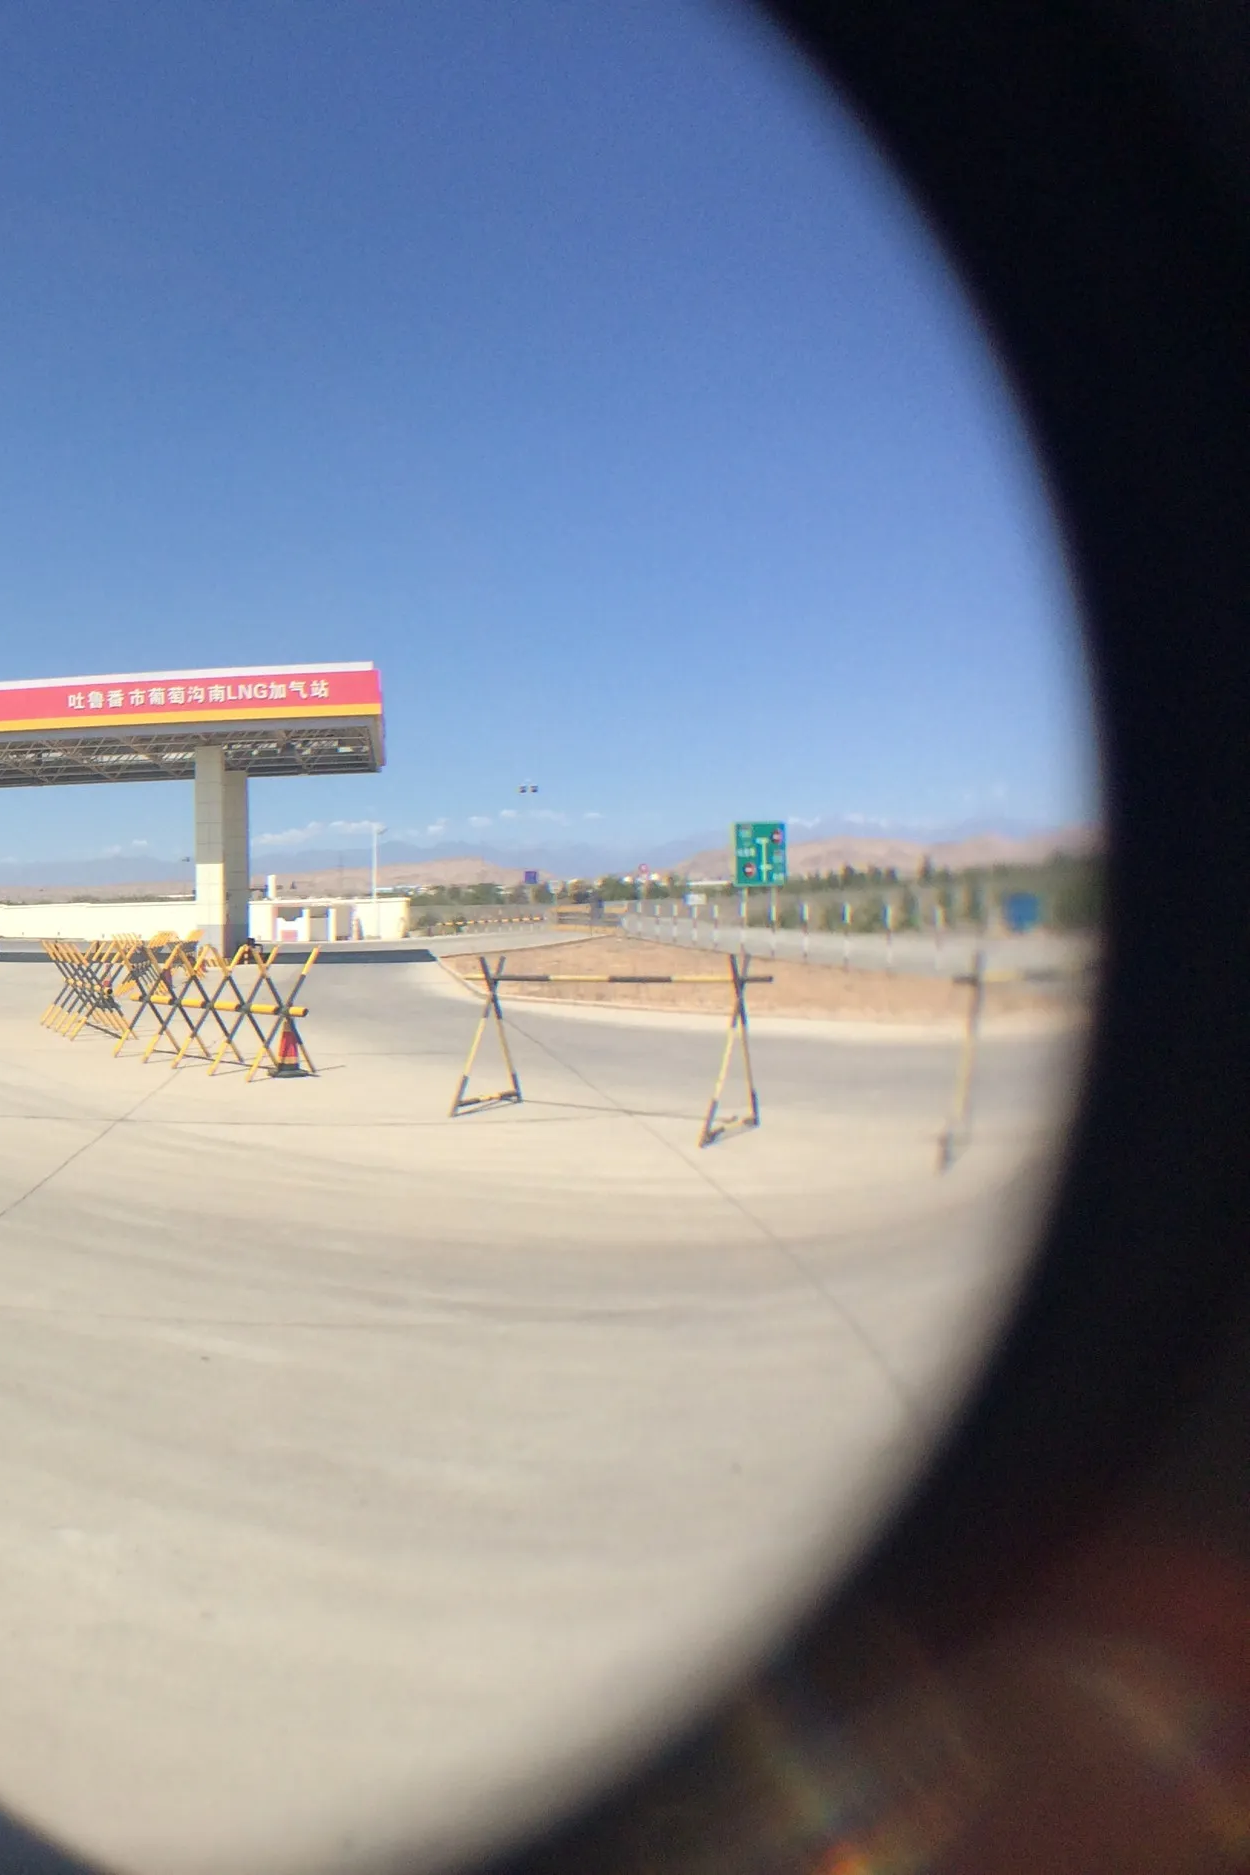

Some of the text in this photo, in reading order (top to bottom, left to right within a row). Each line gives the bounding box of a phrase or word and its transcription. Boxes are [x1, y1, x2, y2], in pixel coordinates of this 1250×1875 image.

[67, 679, 330, 709] 吐鲁番市葡萄沟南LNG加气站
